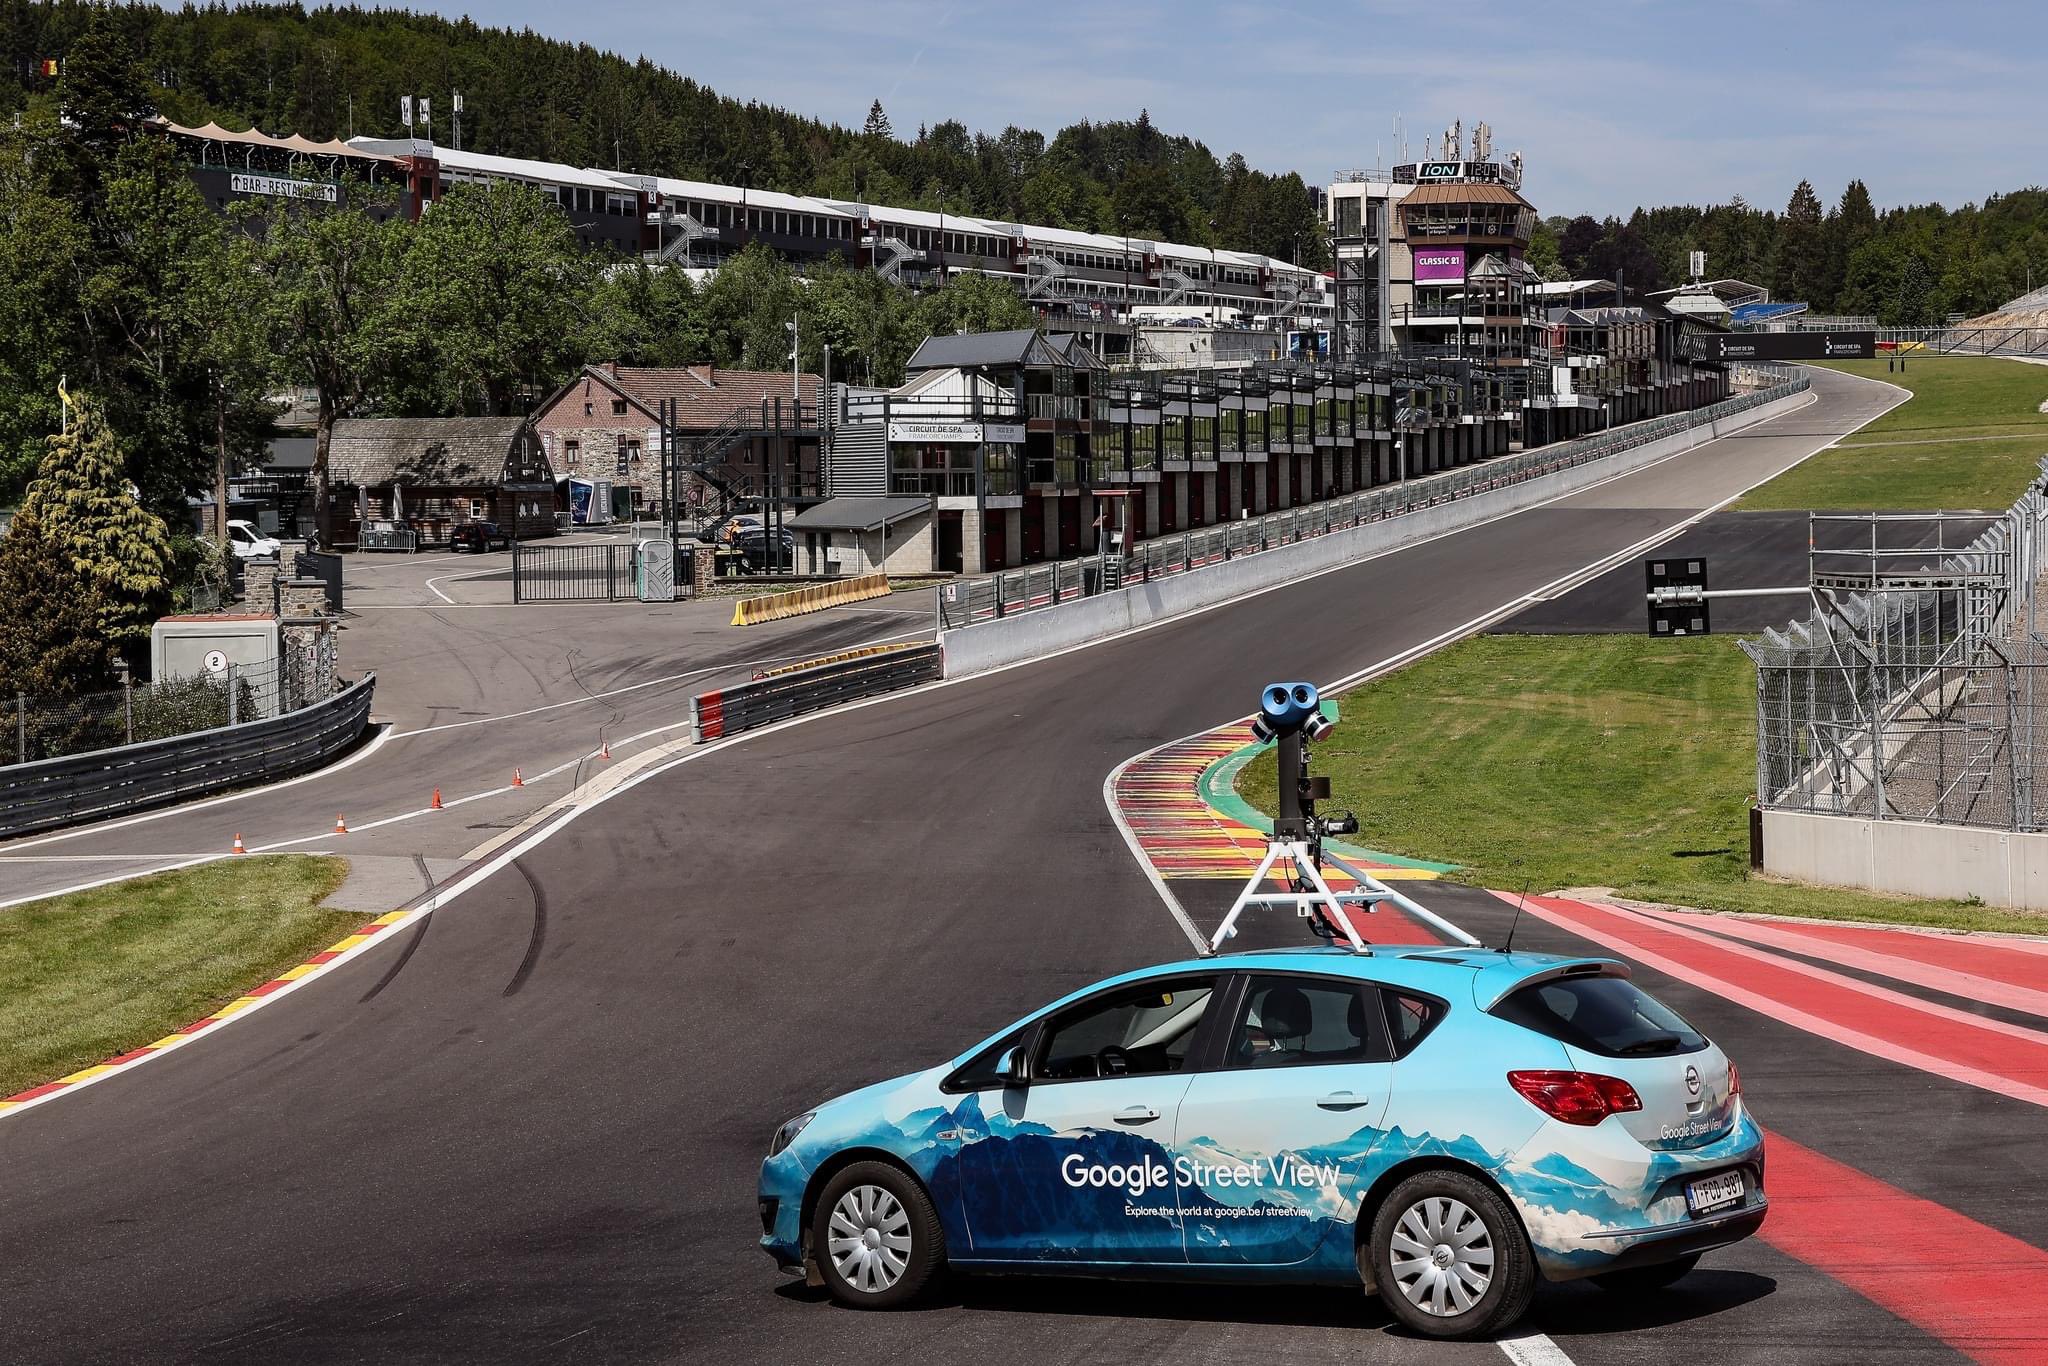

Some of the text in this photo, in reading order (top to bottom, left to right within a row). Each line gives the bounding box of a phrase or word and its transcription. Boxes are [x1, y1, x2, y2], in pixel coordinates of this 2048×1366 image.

[1470, 163, 1498, 177] 12:04
[242, 177, 261, 192] BAR
[269, 180, 328, 199] RESTAUT
[649, 191, 655, 202] 3
[1419, 256, 1460, 265] CLASSIC 21
[908, 425, 963, 433] CIRCUIT DE SPA
[212, 656, 219, 667] 2
[1661, 1117, 1723, 1141] Google Street View
[1061, 1153, 1340, 1197] Google Street View
[1125, 1206, 1159, 1217] Explore
[1159, 1206, 1175, 1216] the
[1176, 1206, 1202, 1217] world
[1203, 1207, 1213, 1217] at
